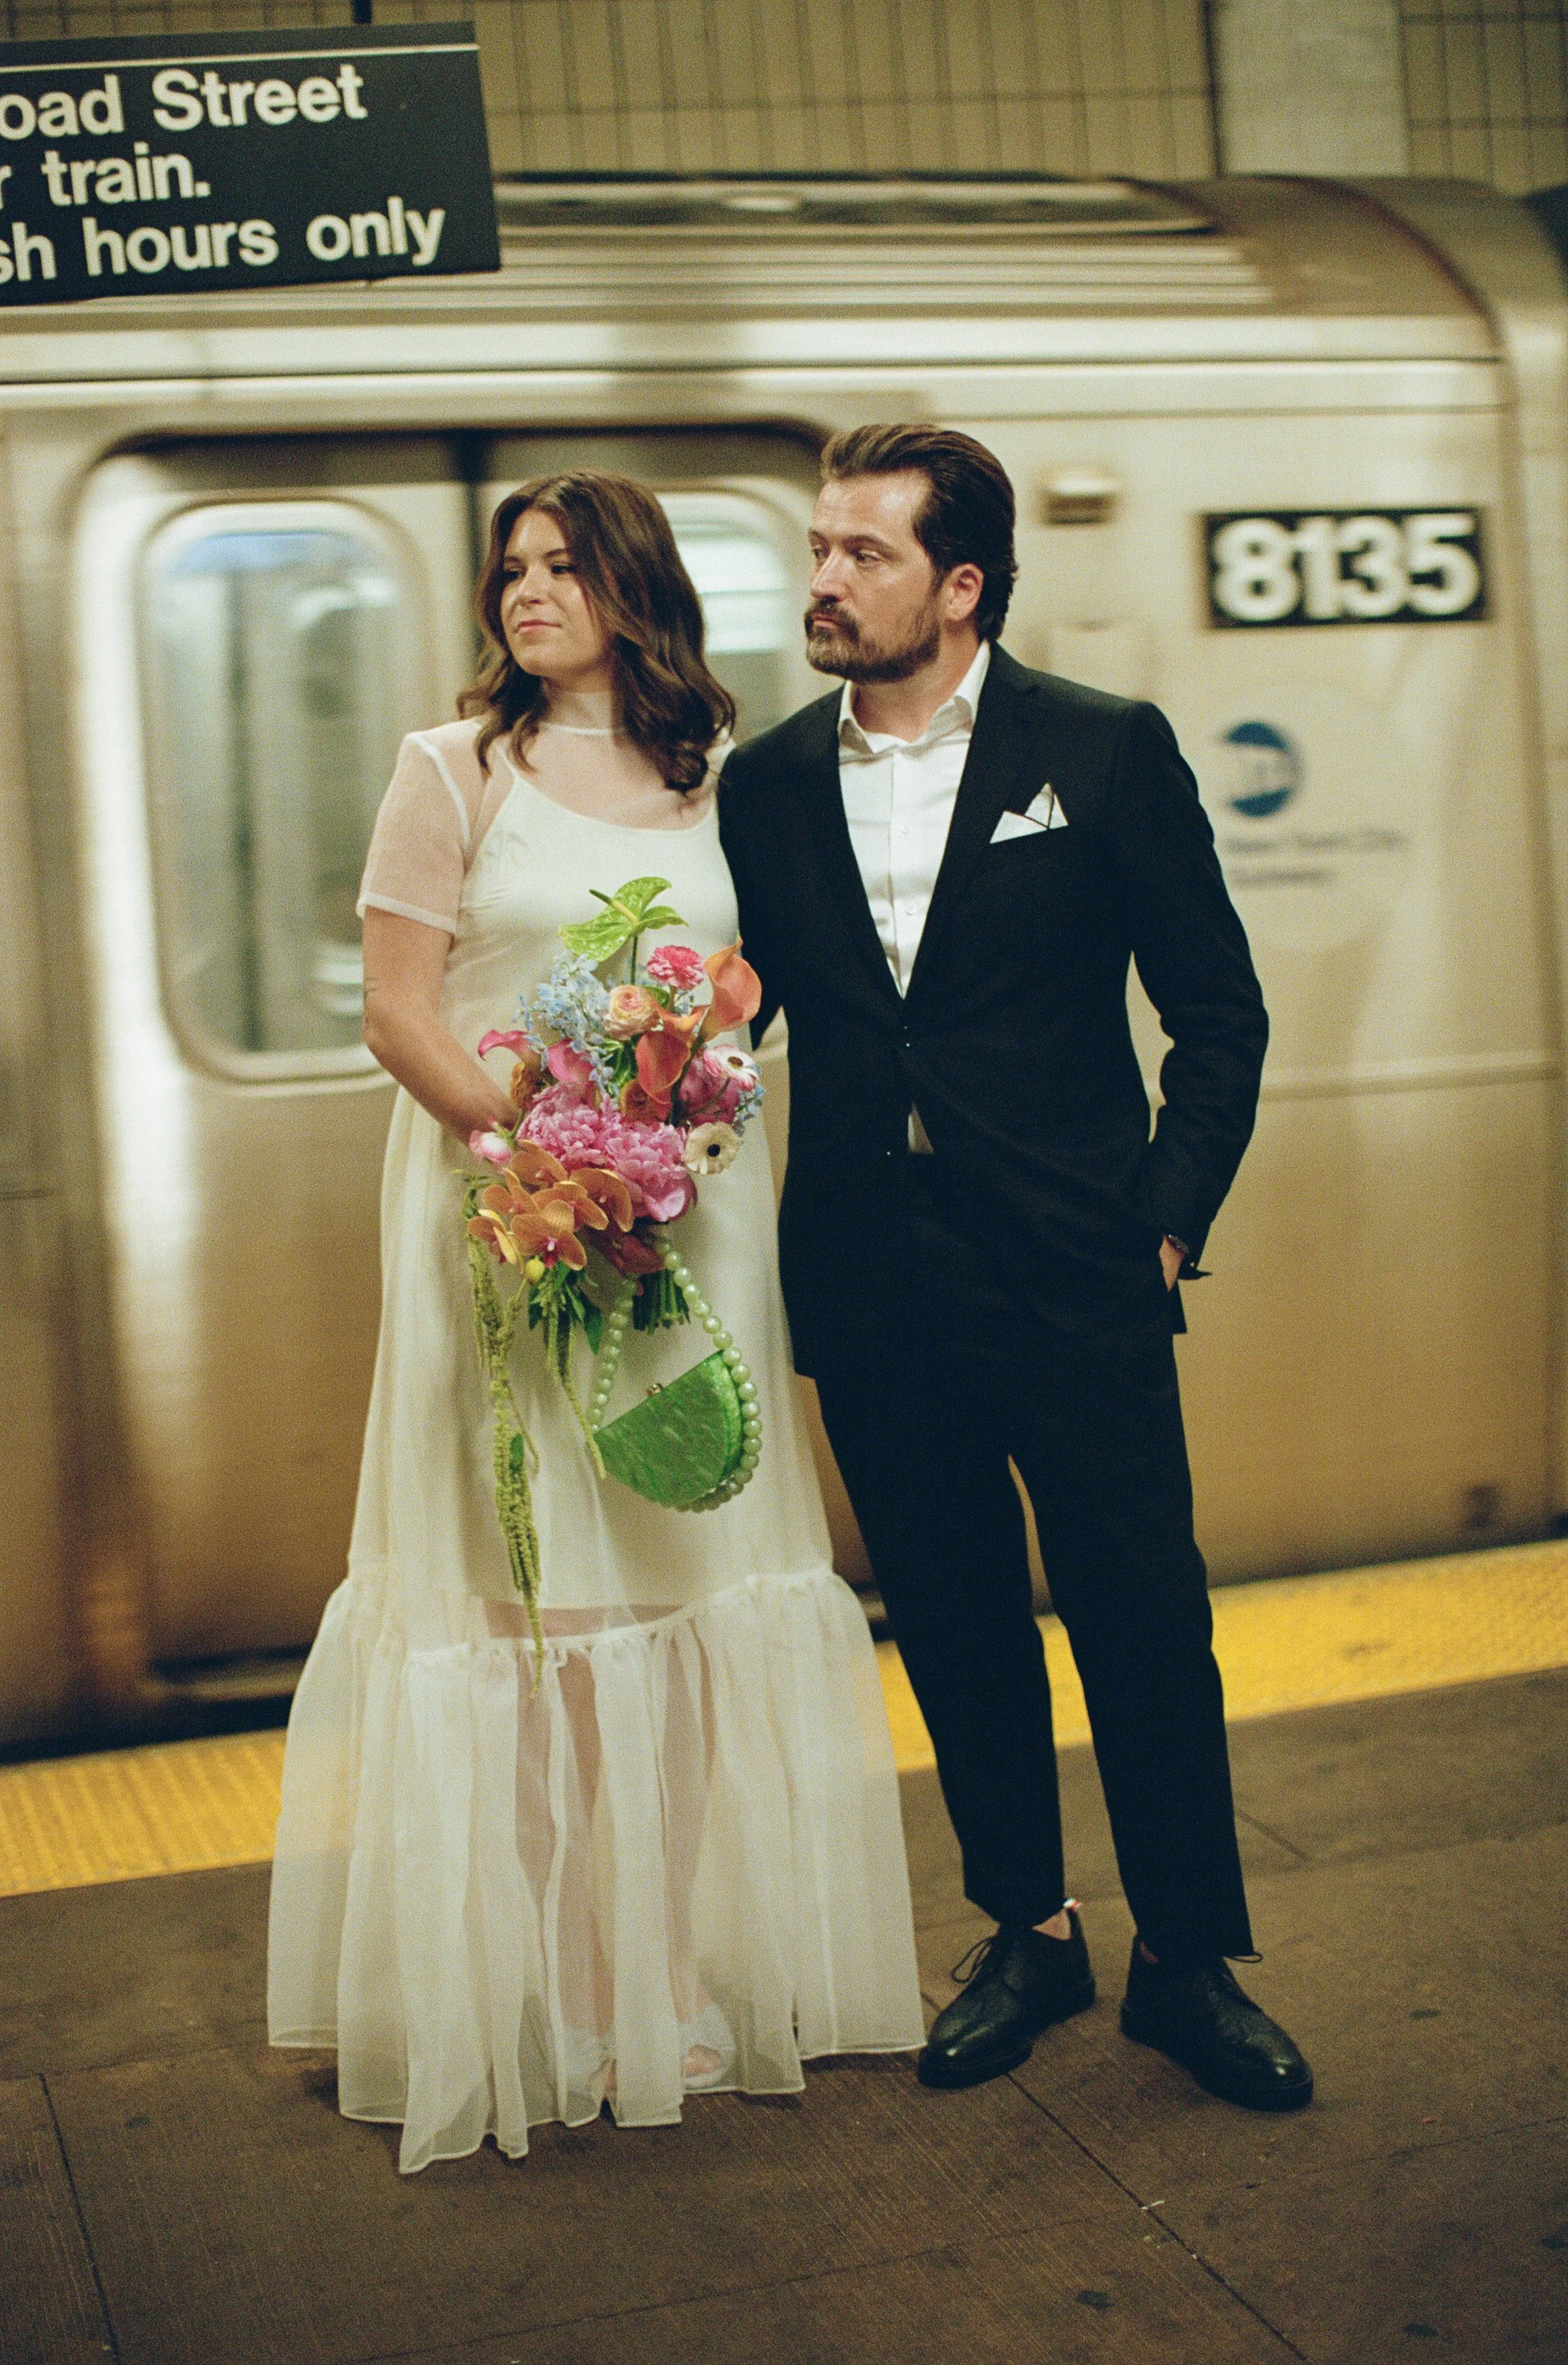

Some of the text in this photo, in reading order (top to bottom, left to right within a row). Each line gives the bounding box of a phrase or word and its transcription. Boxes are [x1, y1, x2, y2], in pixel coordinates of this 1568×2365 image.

[0, 64, 368, 140] oad Street
[41, 141, 211, 206] train.
[82, 217, 279, 276] hours
[306, 196, 445, 266] only
[1212, 512, 1480, 623] 8135
